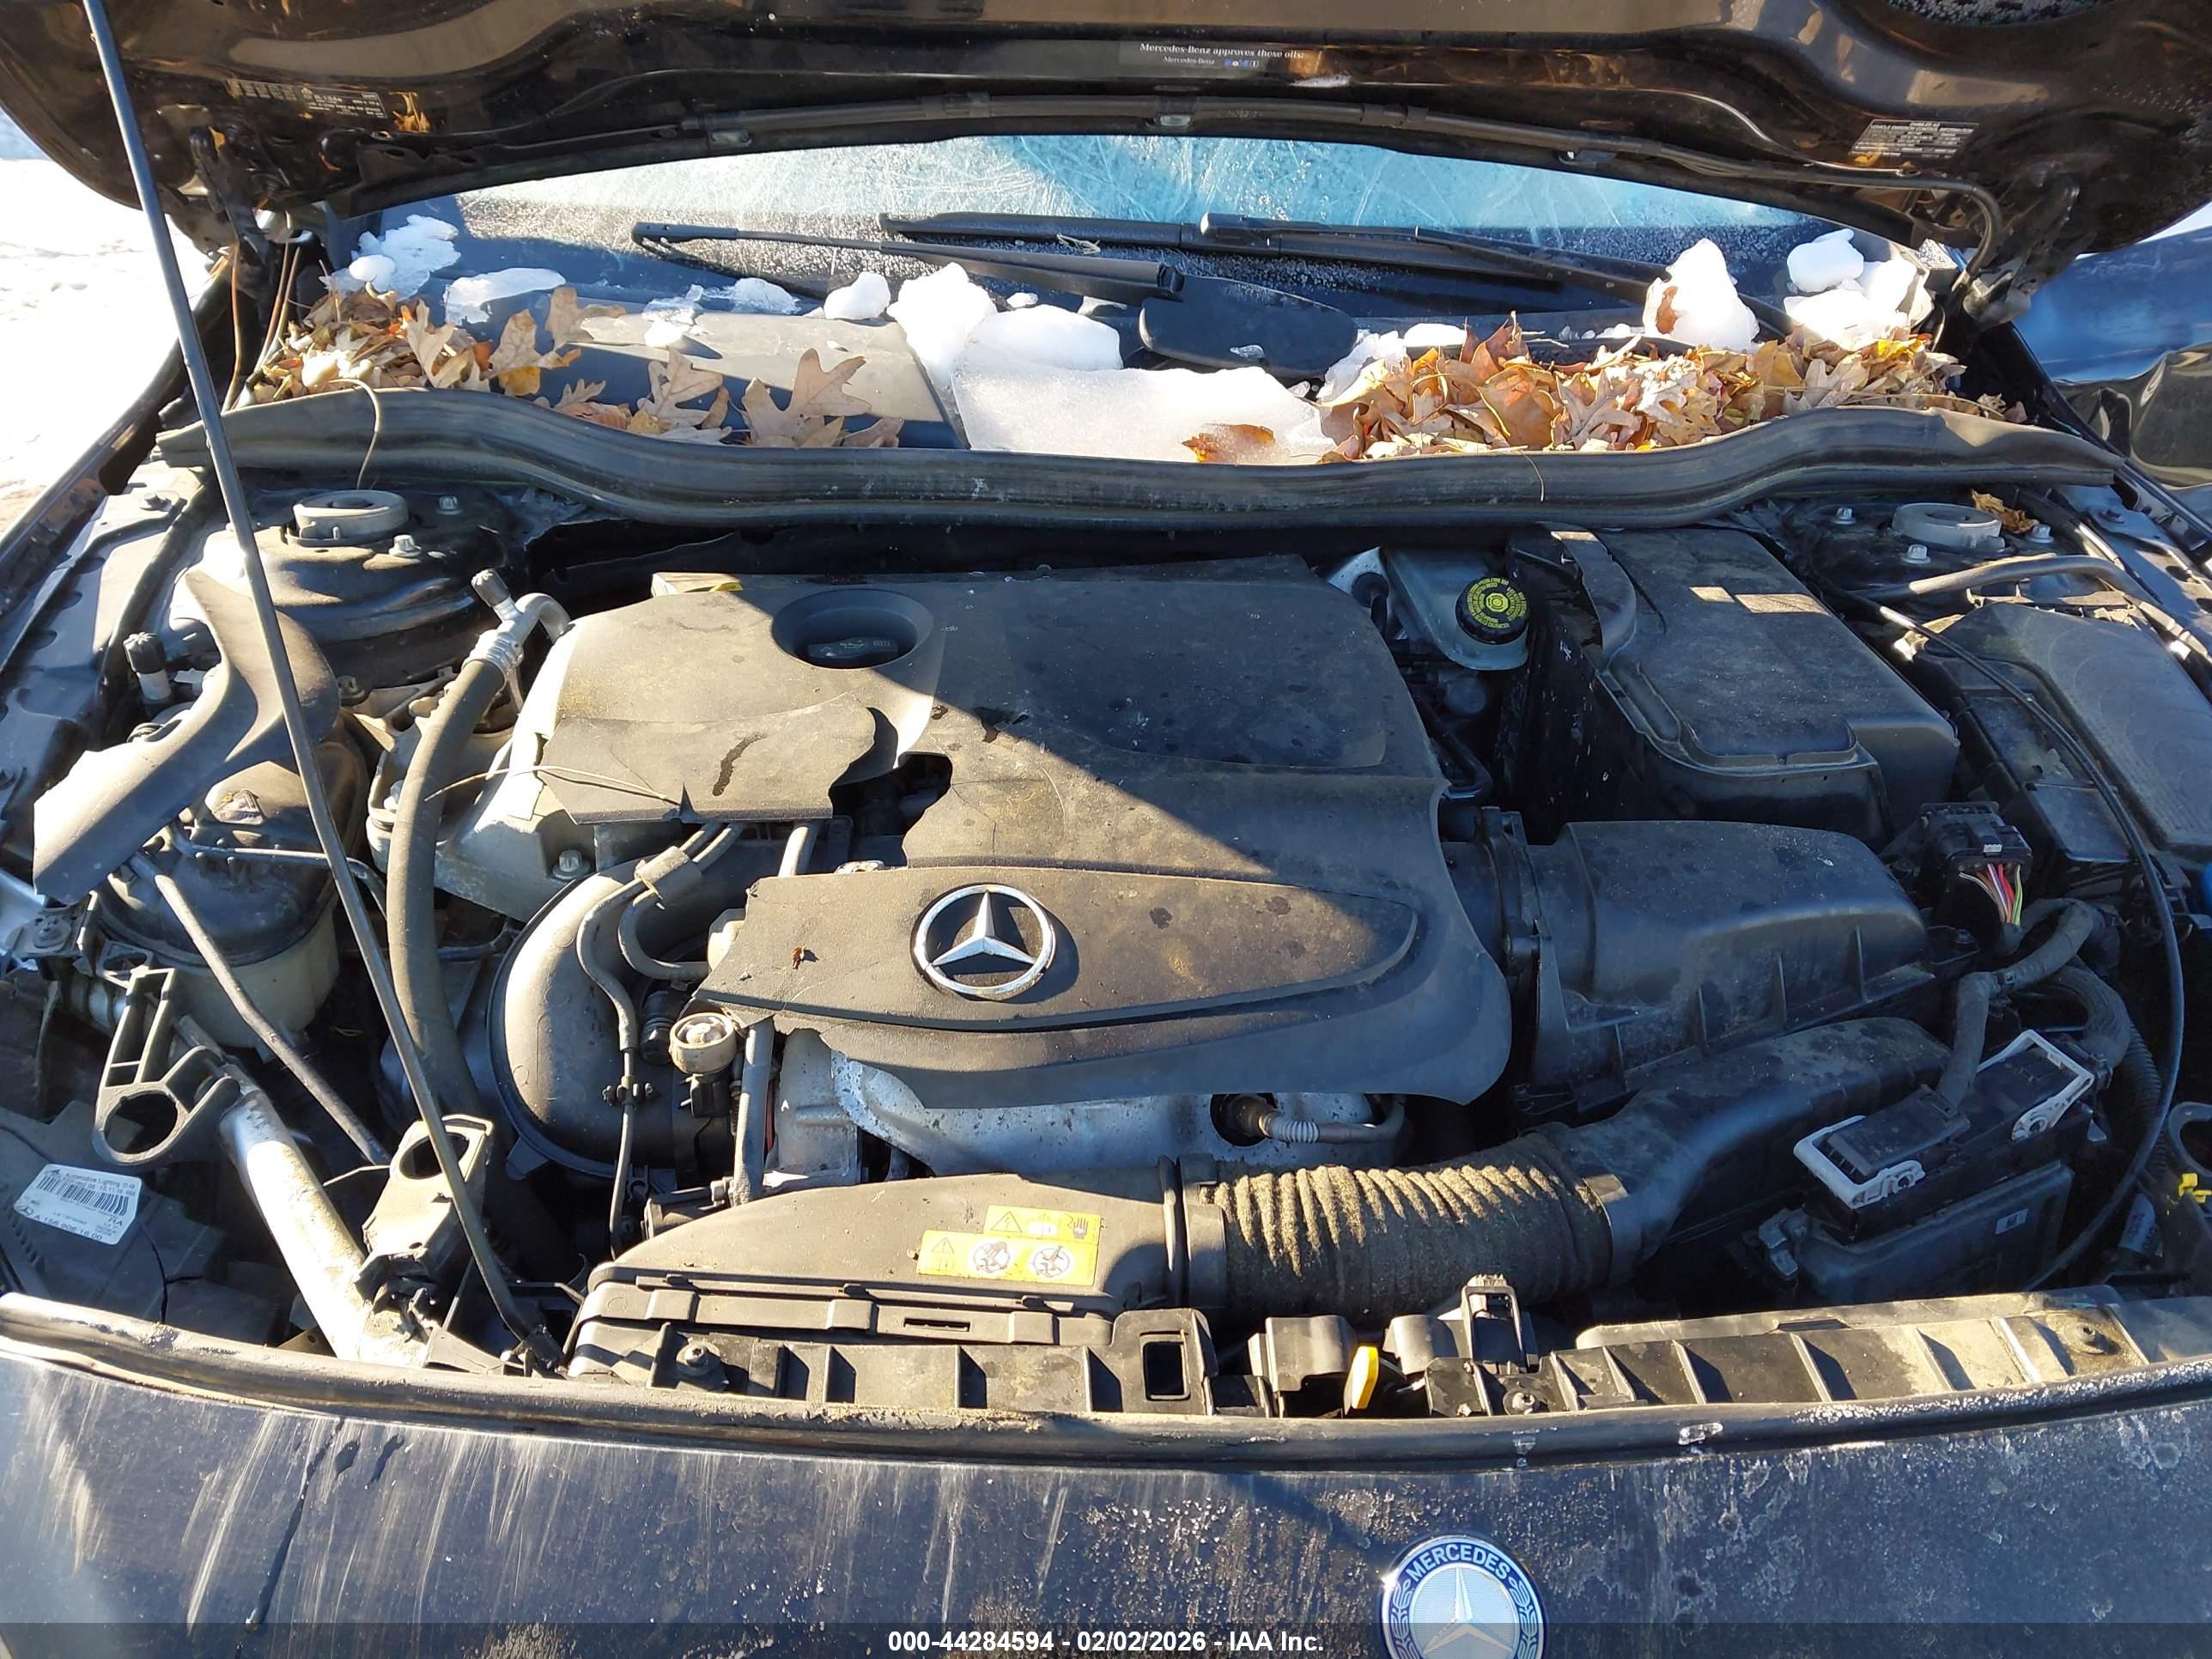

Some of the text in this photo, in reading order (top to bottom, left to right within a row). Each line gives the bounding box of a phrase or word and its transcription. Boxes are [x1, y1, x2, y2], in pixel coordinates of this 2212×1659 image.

[1139, 43, 1211, 55] Mercedes-Benz
[1212, 49, 1255, 58] approves
[1257, 49, 1283, 58] these
[1164, 56, 1215, 65] Mercedes-Benz
[1406, 1543, 1510, 1582] MERCEDES
